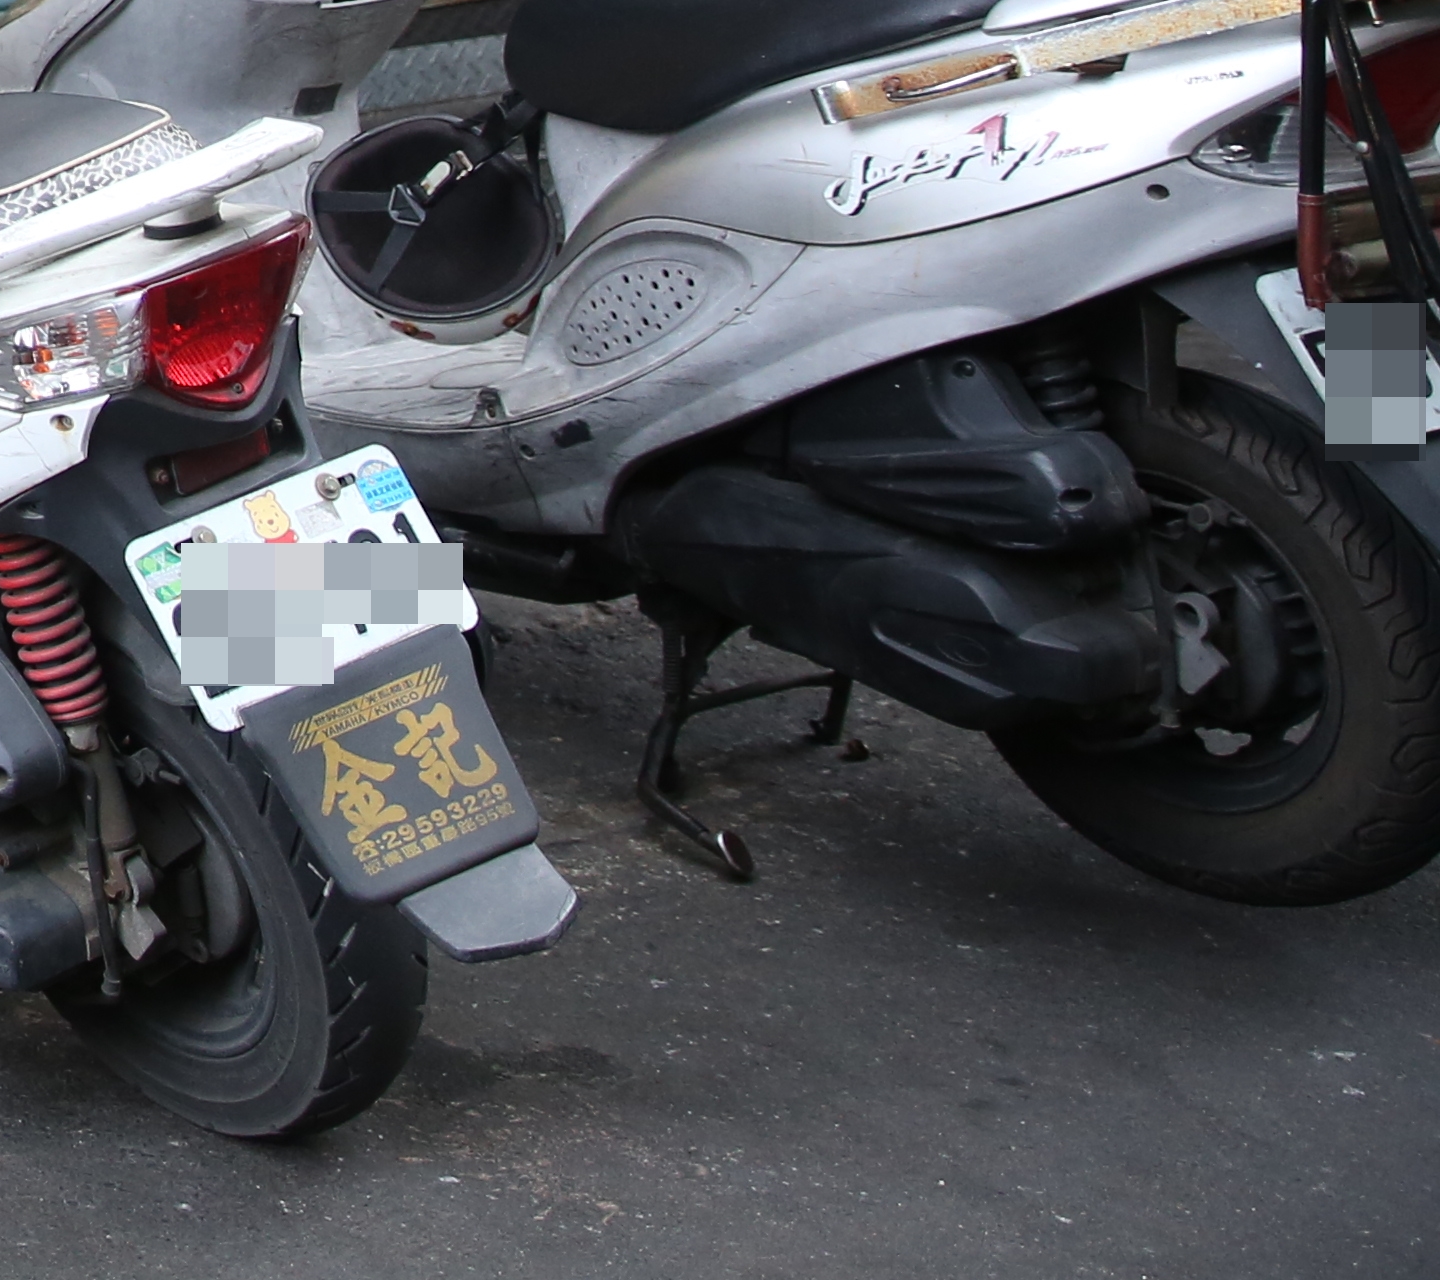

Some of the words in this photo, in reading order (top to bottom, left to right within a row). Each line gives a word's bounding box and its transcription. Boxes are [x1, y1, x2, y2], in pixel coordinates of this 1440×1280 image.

[322, 713, 367, 739] YAMAHA
[374, 690, 419, 716] KYMCO
[321, 702, 497, 844] 金記
